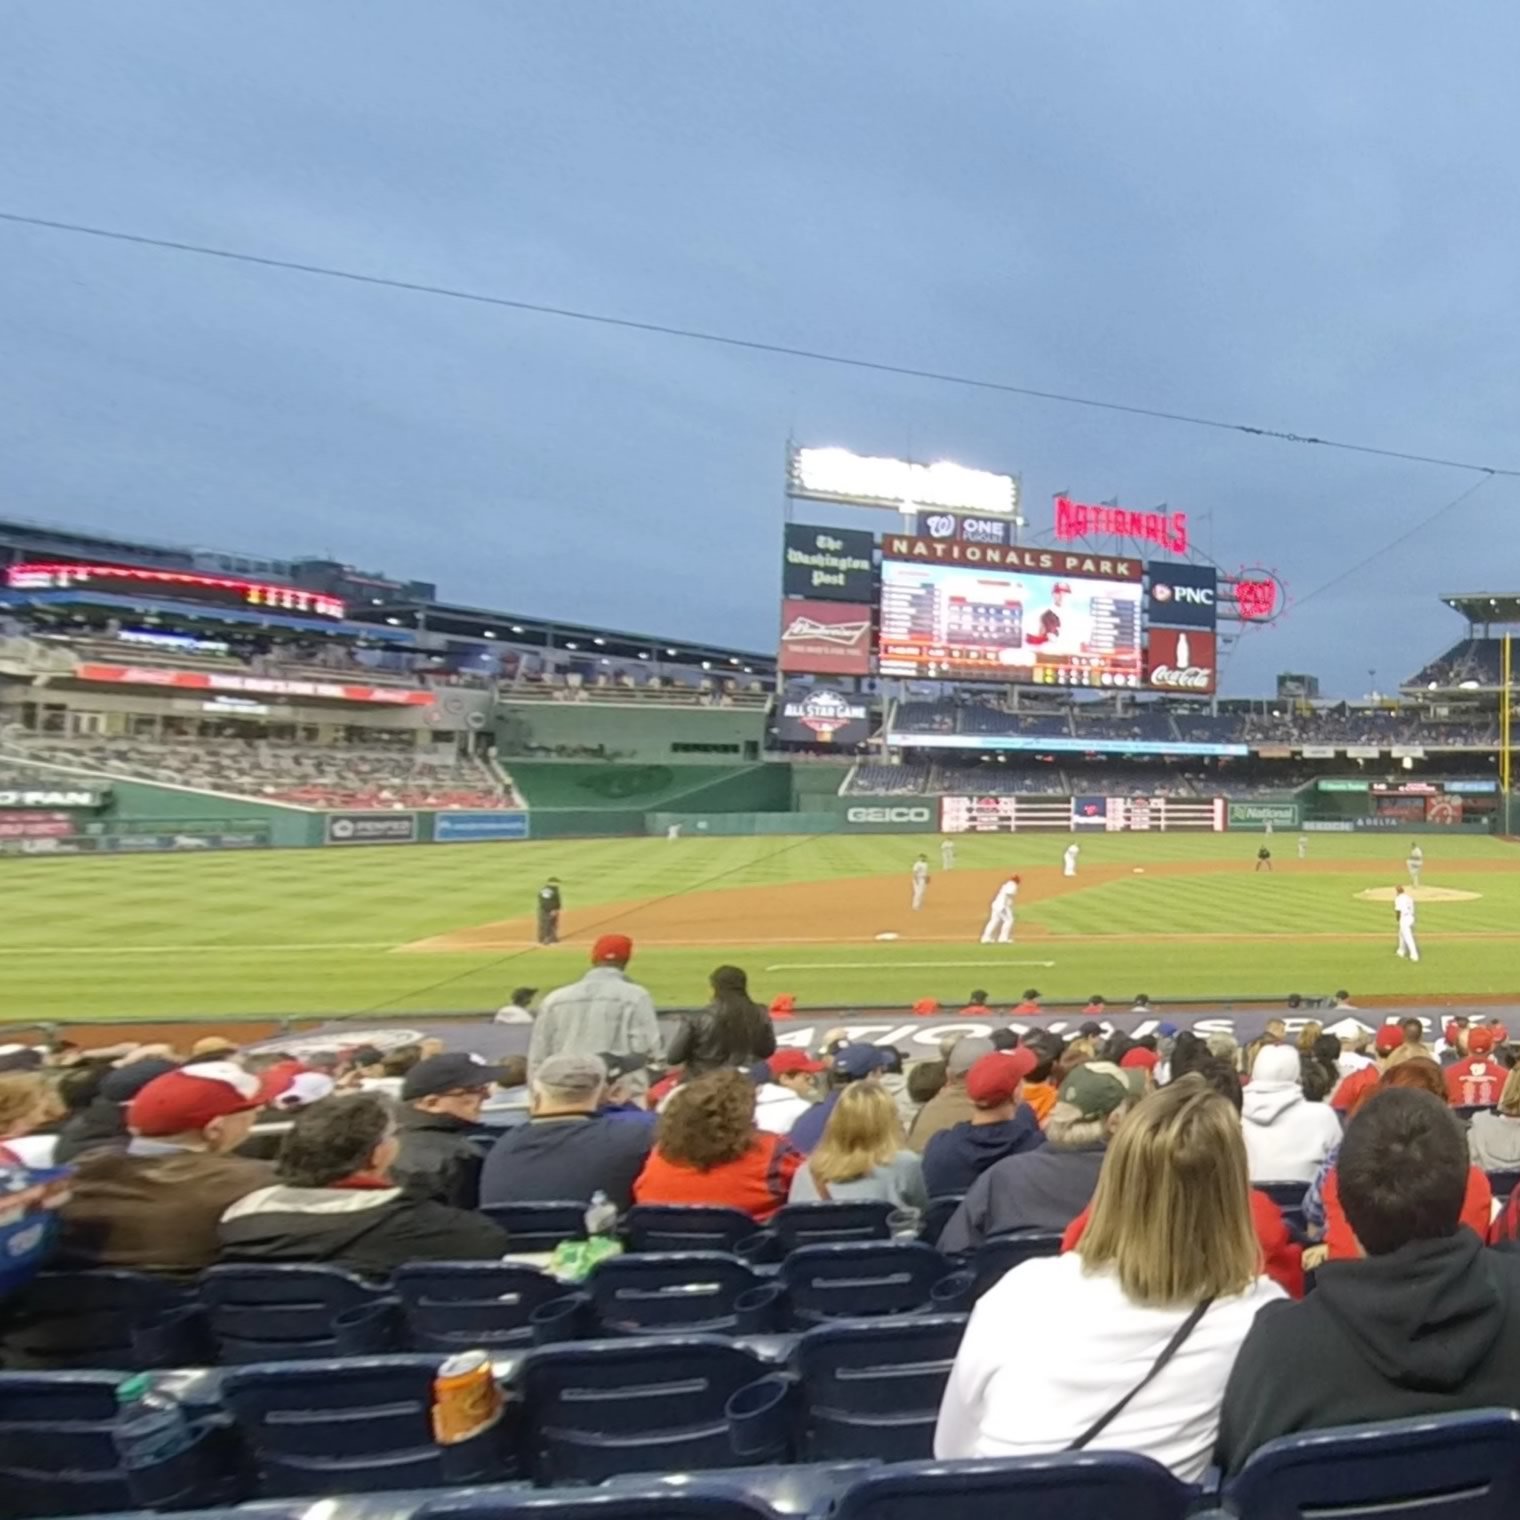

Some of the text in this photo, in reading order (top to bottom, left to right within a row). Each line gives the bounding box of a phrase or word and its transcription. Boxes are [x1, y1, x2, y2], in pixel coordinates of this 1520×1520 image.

[963, 520, 1004, 536] ONE
[1055, 497, 1188, 555] NATIONALS
[815, 535, 843, 551] The
[787, 547, 871, 571] Washington
[892, 539, 1131, 576] NATIONALS PARK
[811, 569, 846, 587] Post
[1174, 585, 1214, 604] PNC
[784, 703, 867, 719] ALL STAR GAME
[847, 807, 931, 823] GEICO
[1247, 806, 1293, 819] National
[1365, 818, 1398, 827] DELTA
